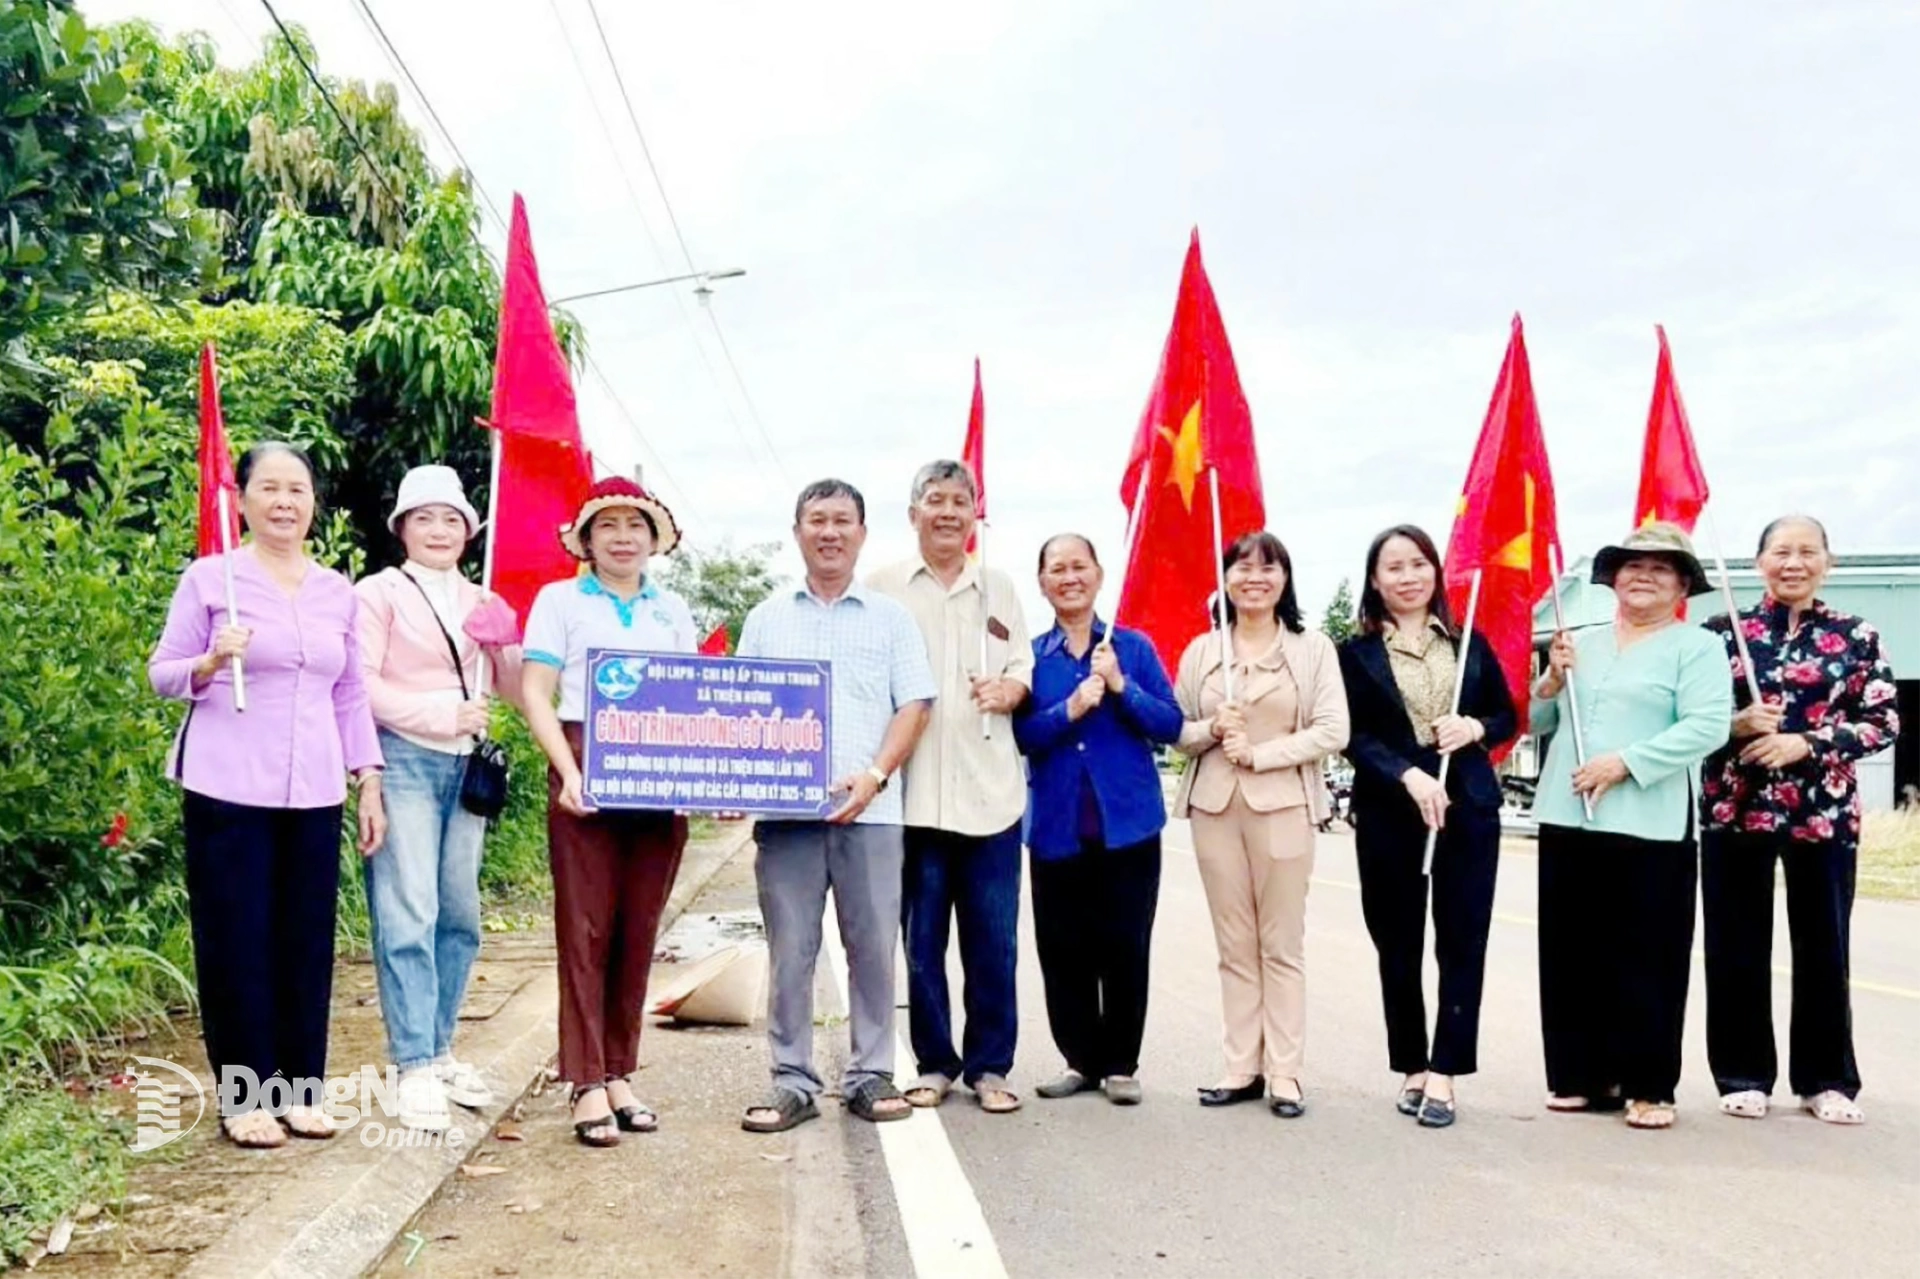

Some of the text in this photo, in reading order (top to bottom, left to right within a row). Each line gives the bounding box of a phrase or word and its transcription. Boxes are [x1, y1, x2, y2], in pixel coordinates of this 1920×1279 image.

[667, 665, 694, 681] LHPN
[702, 667, 720, 682] CHI
[787, 671, 820, 686] TRUNG
[596, 703, 639, 744] CÔNG
[640, 706, 687, 746] TRÌNH
[740, 709, 761, 749] CỜ
[762, 706, 782, 749] TỔ
[782, 708, 823, 753] QUỐC
